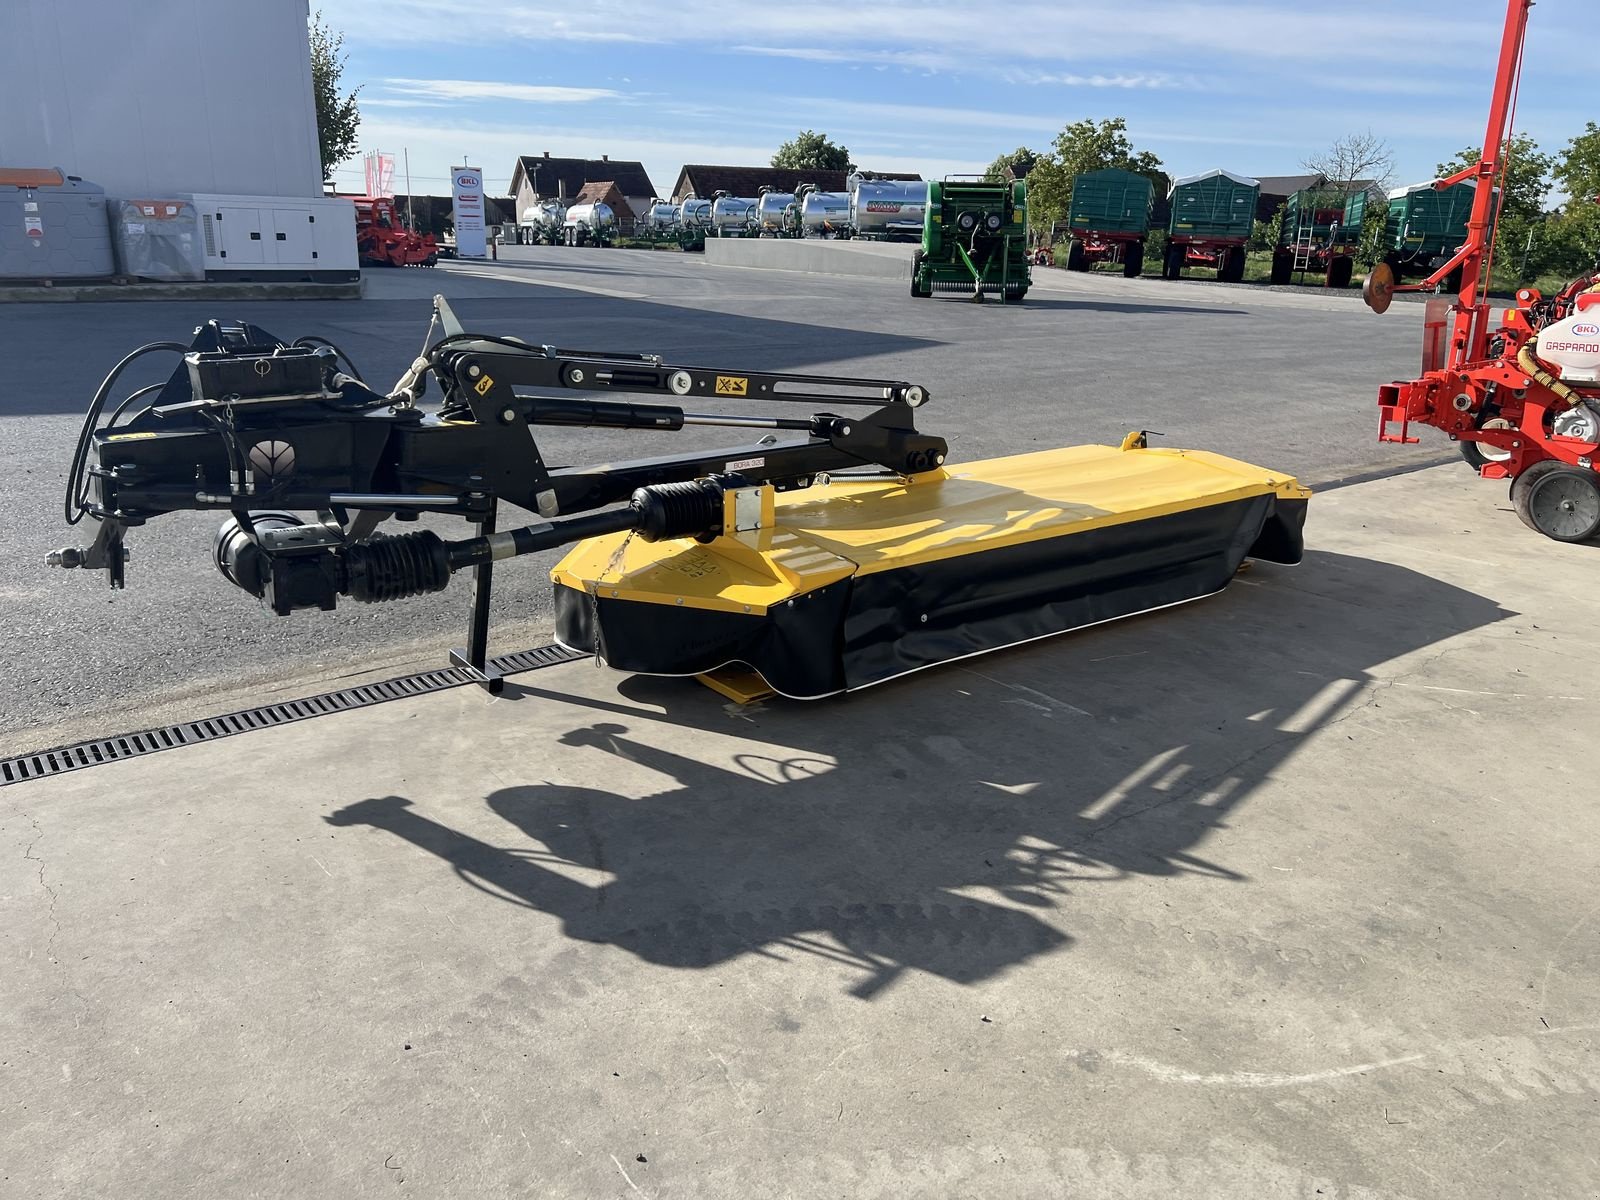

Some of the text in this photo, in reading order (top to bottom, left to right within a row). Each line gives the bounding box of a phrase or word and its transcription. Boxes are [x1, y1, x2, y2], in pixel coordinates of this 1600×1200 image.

[1576, 325, 1596, 334] BKL
[1545, 341, 1600, 353] GASPARDO
[733, 460, 750, 470] BORA
